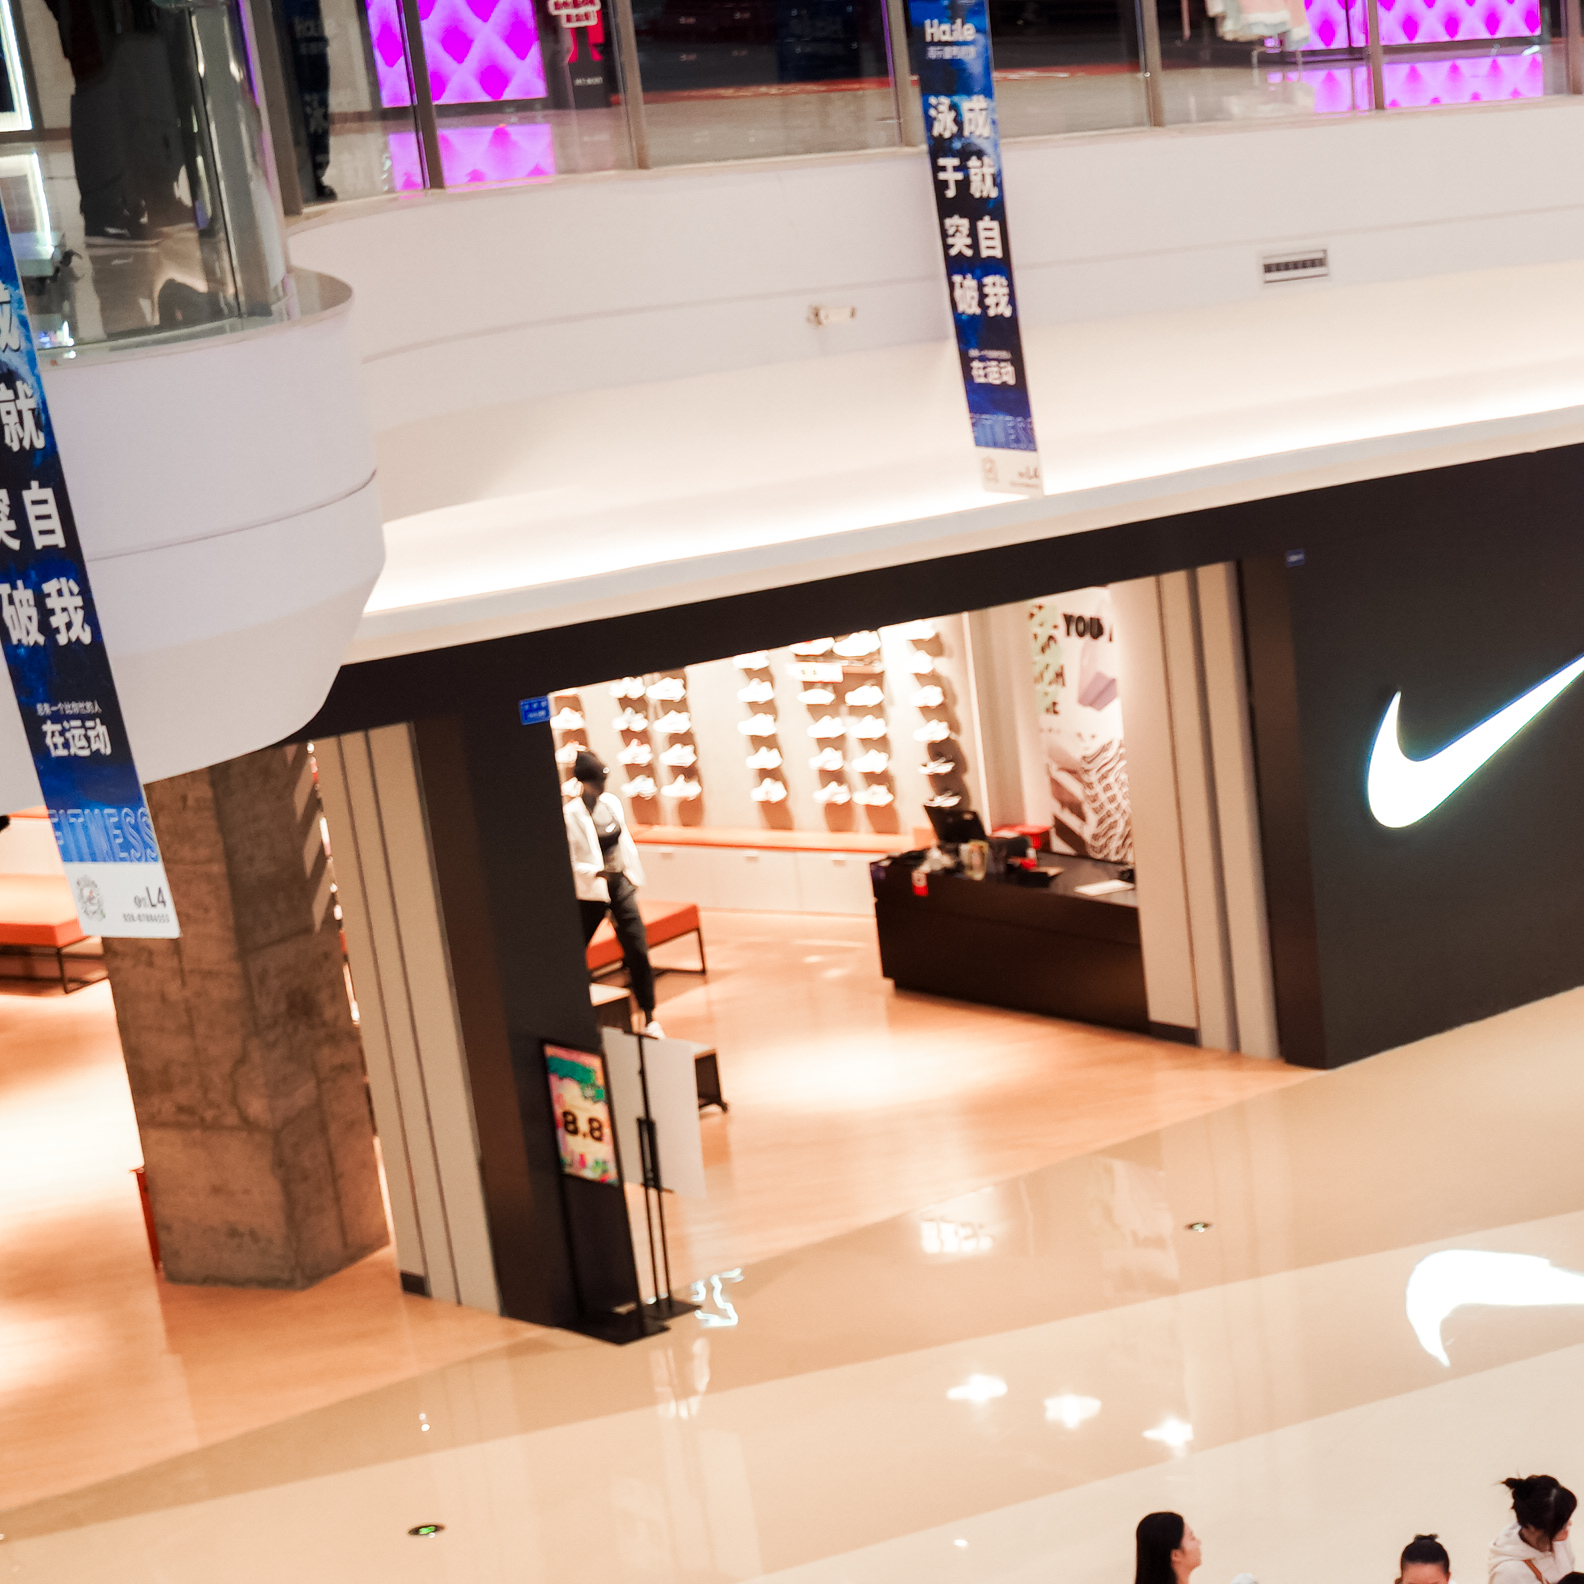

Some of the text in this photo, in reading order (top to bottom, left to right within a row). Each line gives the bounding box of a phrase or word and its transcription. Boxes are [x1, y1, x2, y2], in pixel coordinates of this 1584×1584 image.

[42, 718, 112, 757] 在运动
[562, 1110, 604, 1141] 8.8
